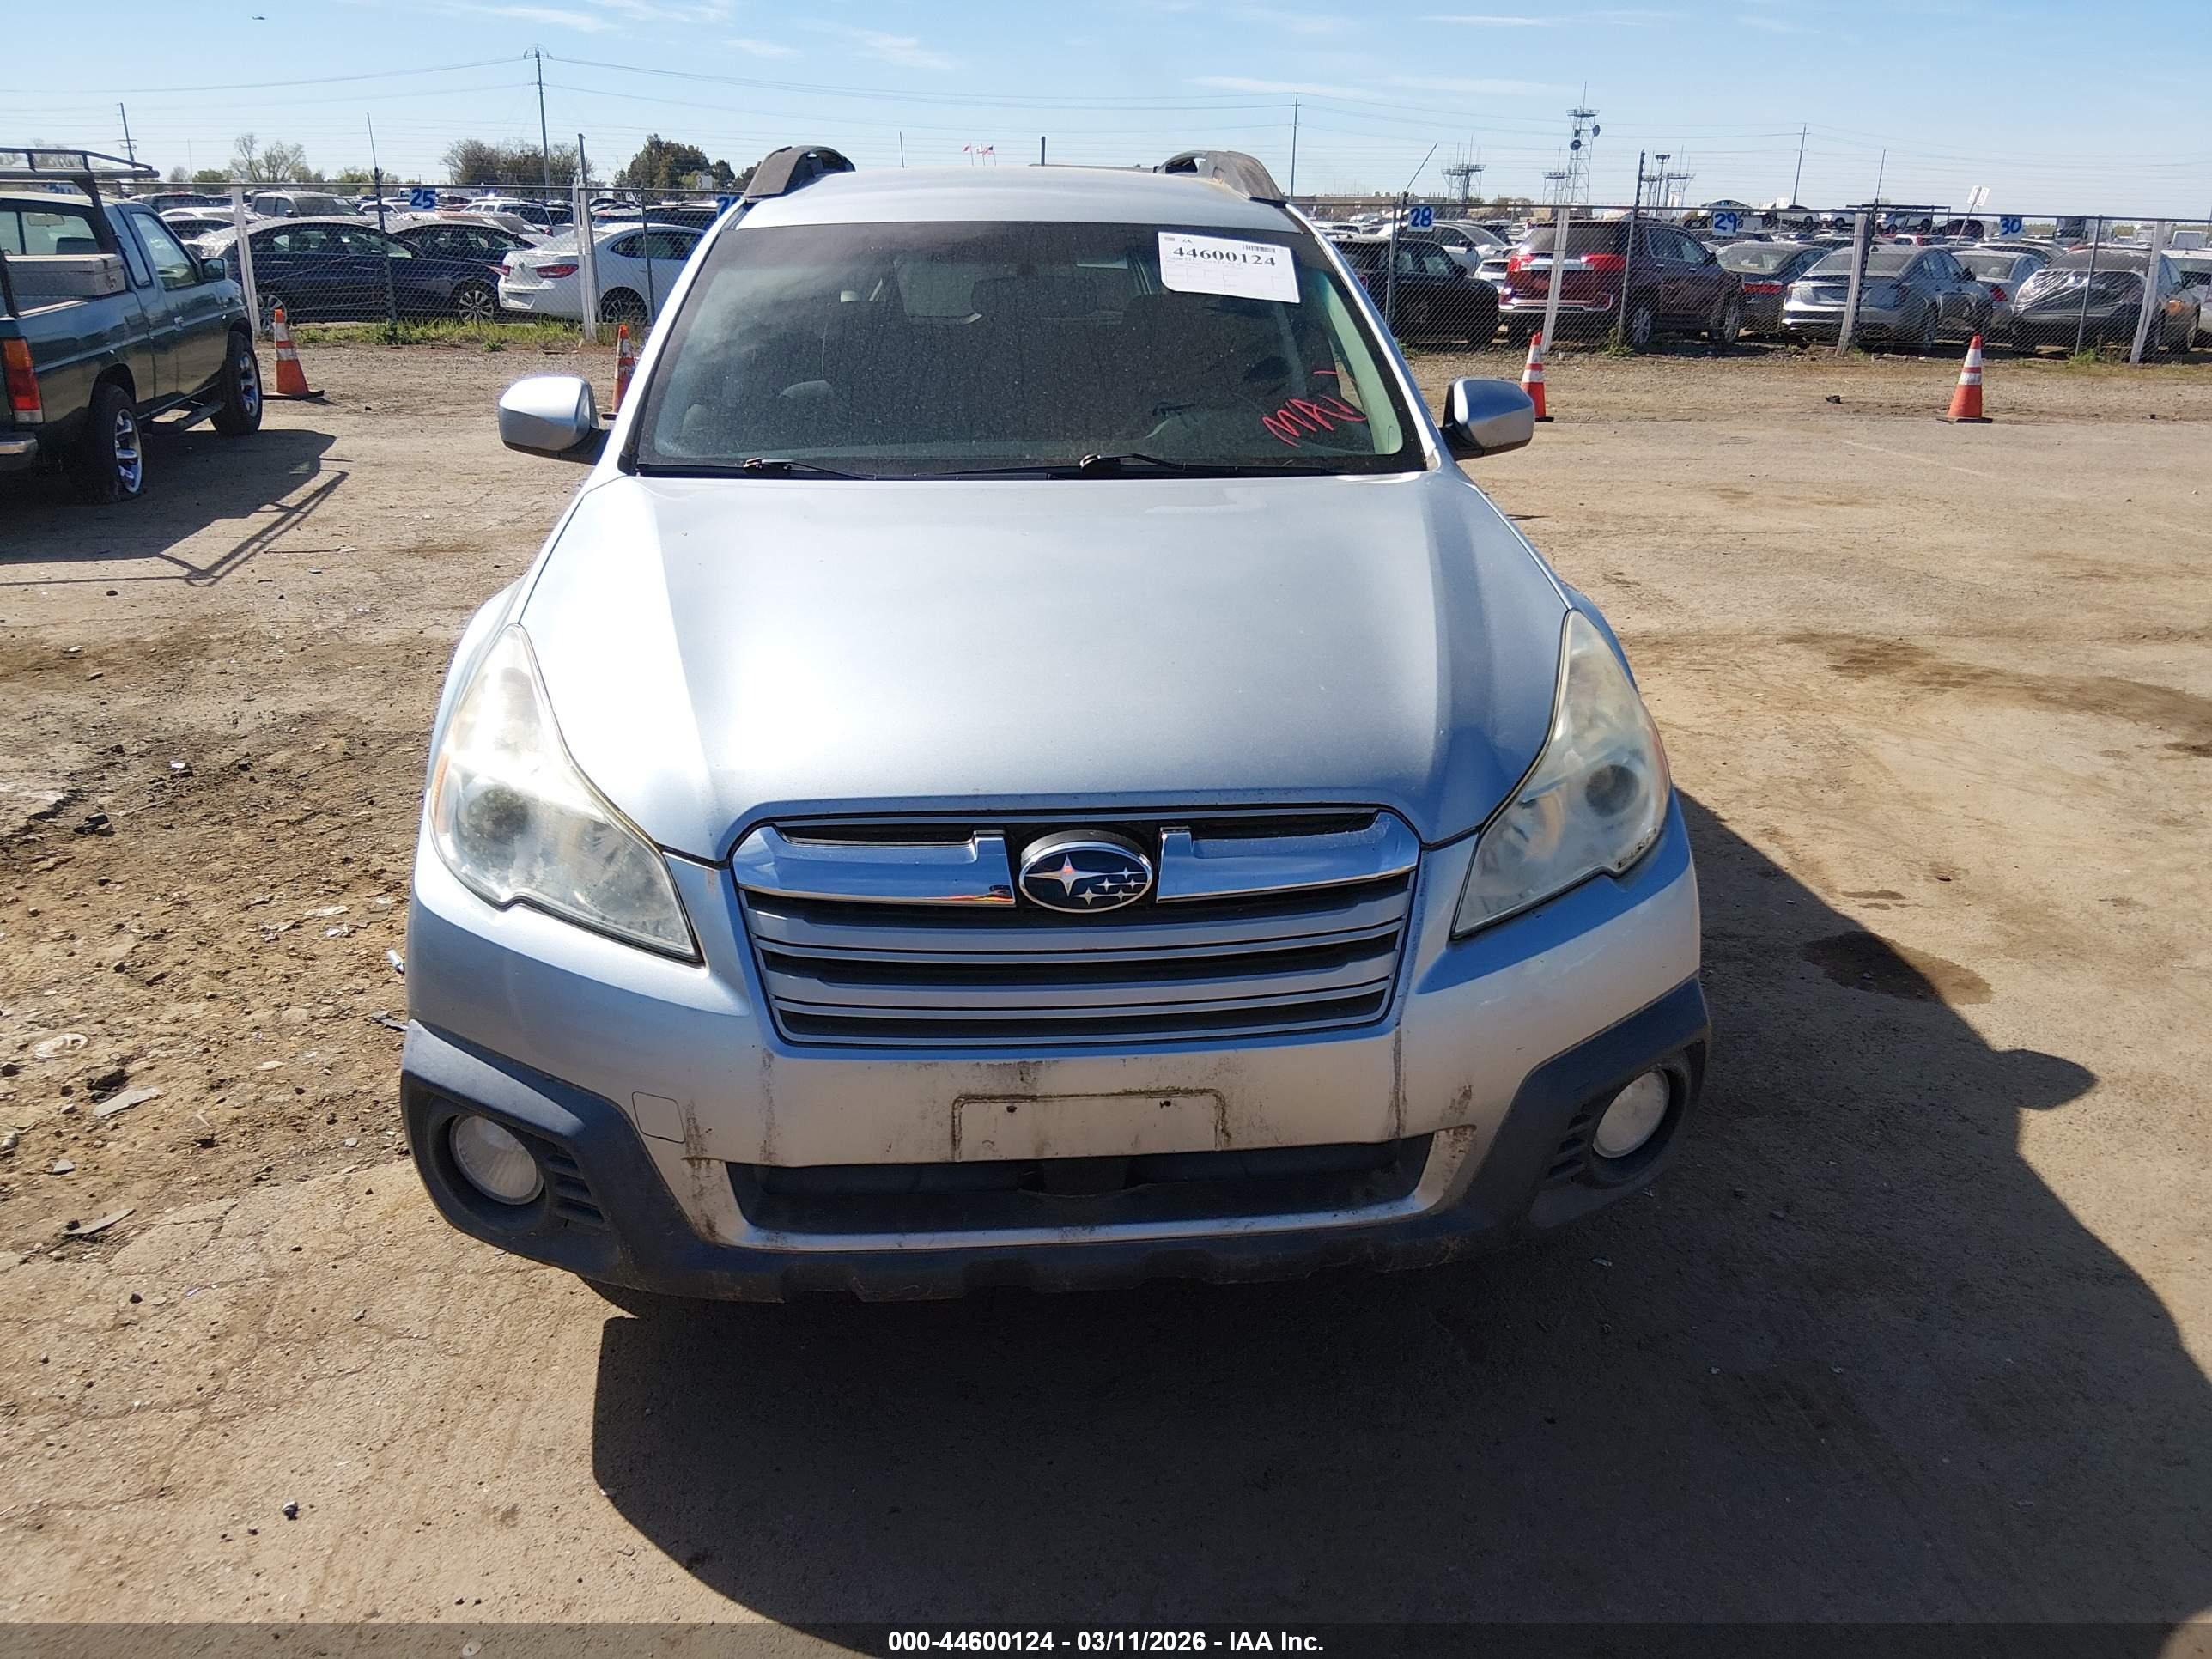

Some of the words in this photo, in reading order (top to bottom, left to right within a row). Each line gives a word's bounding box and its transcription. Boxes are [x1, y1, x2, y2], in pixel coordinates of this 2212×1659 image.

[410, 187, 435, 209] 25
[1410, 206, 1432, 227] 28
[1714, 212, 1737, 233] 29
[2000, 217, 2022, 235] 30
[1173, 246, 1276, 267] 44600124
